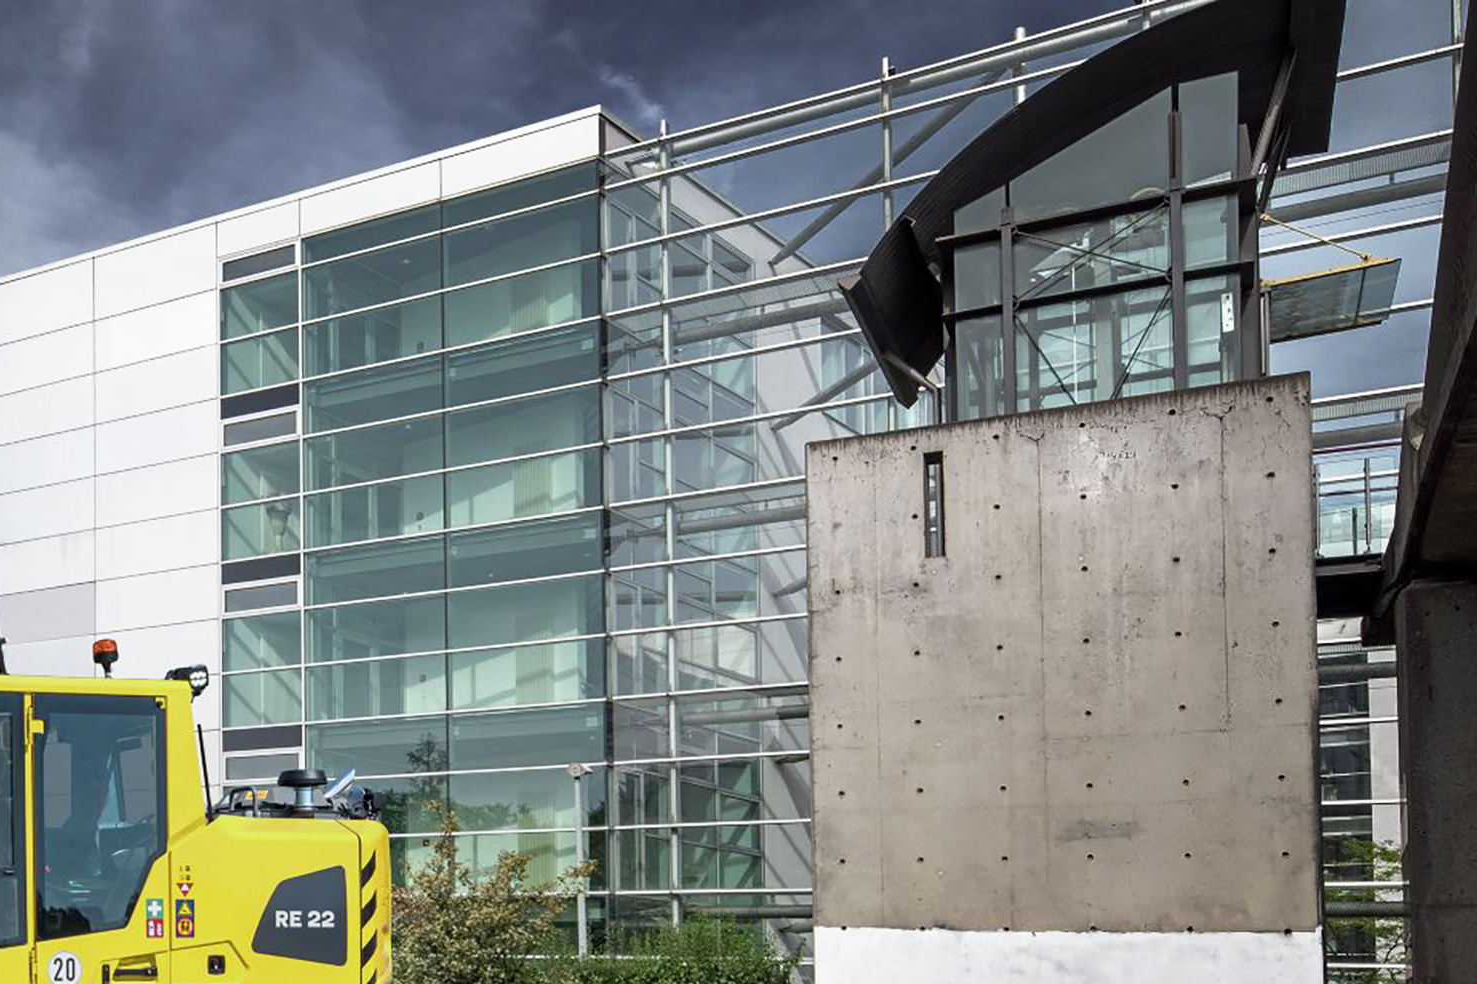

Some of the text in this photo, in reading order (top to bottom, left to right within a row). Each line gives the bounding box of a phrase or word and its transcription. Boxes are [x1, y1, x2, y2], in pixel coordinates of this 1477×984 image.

[275, 910, 335, 928] RE 22
[53, 957, 76, 982] 20
